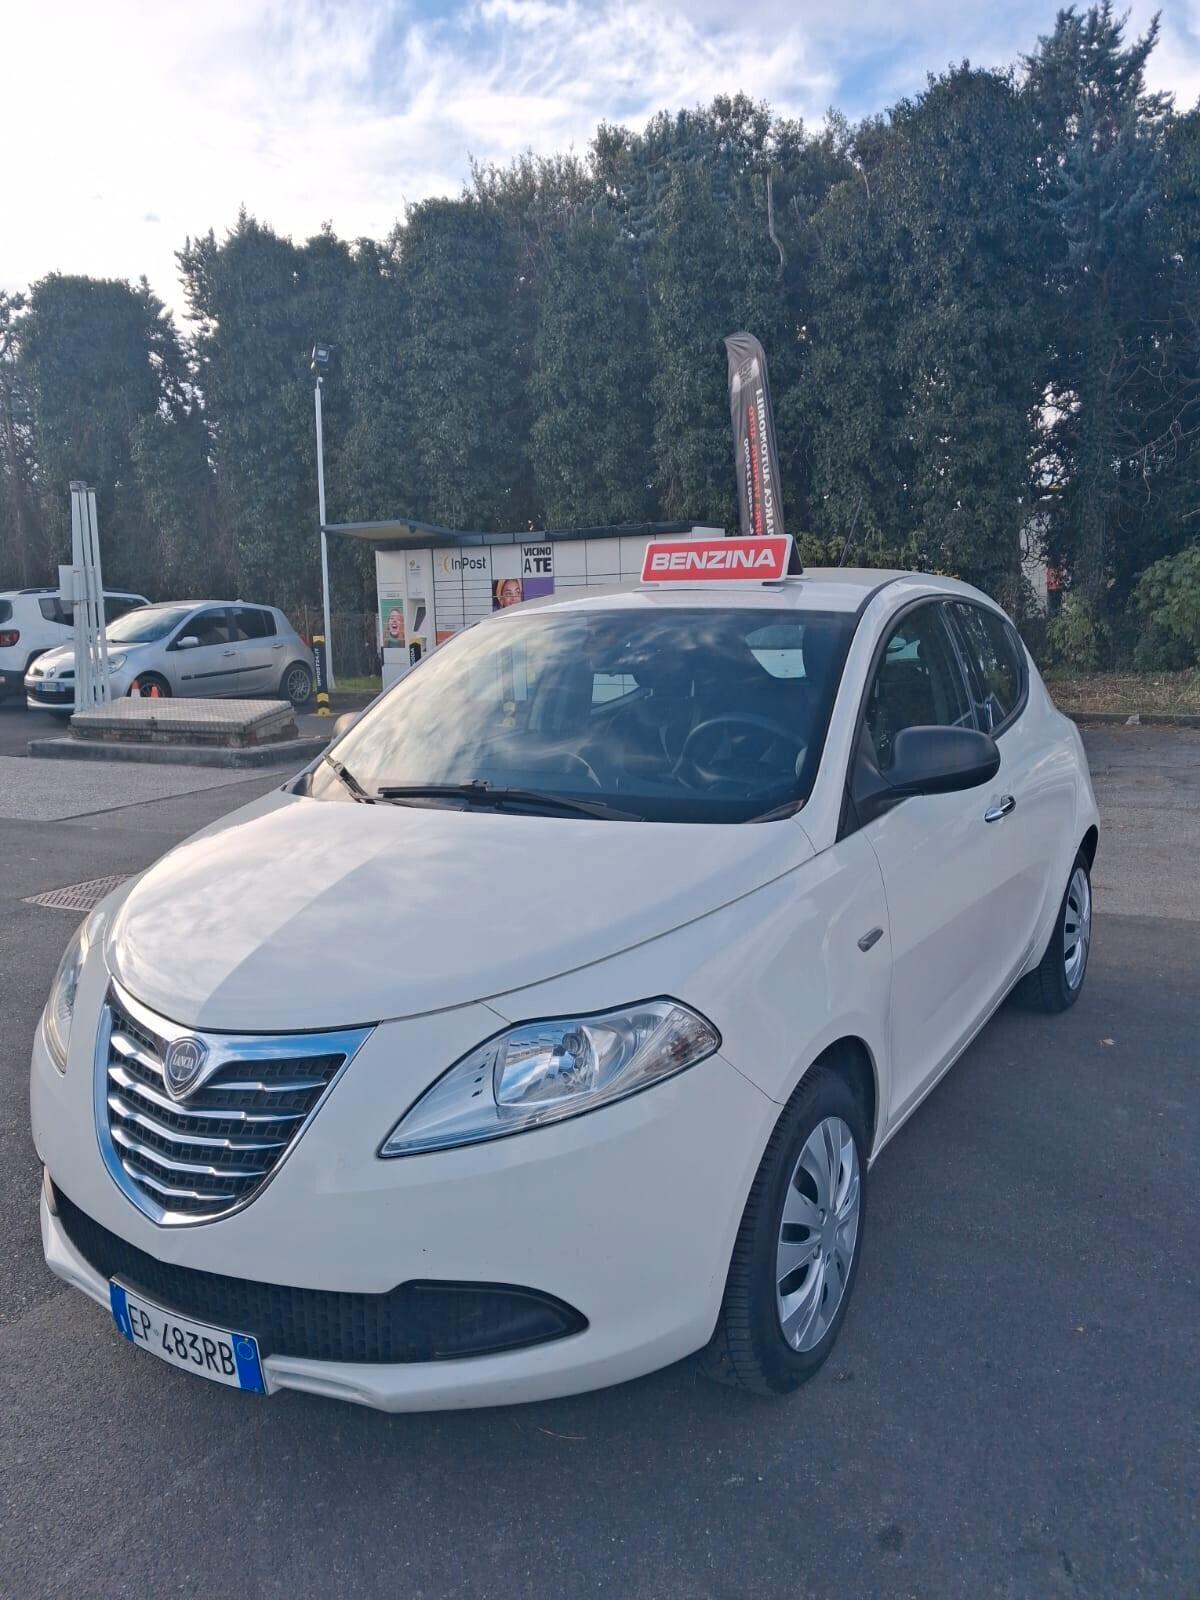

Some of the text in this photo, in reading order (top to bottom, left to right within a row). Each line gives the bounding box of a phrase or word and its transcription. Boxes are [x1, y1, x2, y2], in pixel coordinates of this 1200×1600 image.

[523, 547, 551, 557] VICINO
[651, 549, 776, 571] BENZINA
[451, 556, 486, 570] InPost
[524, 557, 552, 574] A TE
[172, 1054, 194, 1070] LANCIA
[128, 1303, 236, 1376] EP 483RB
